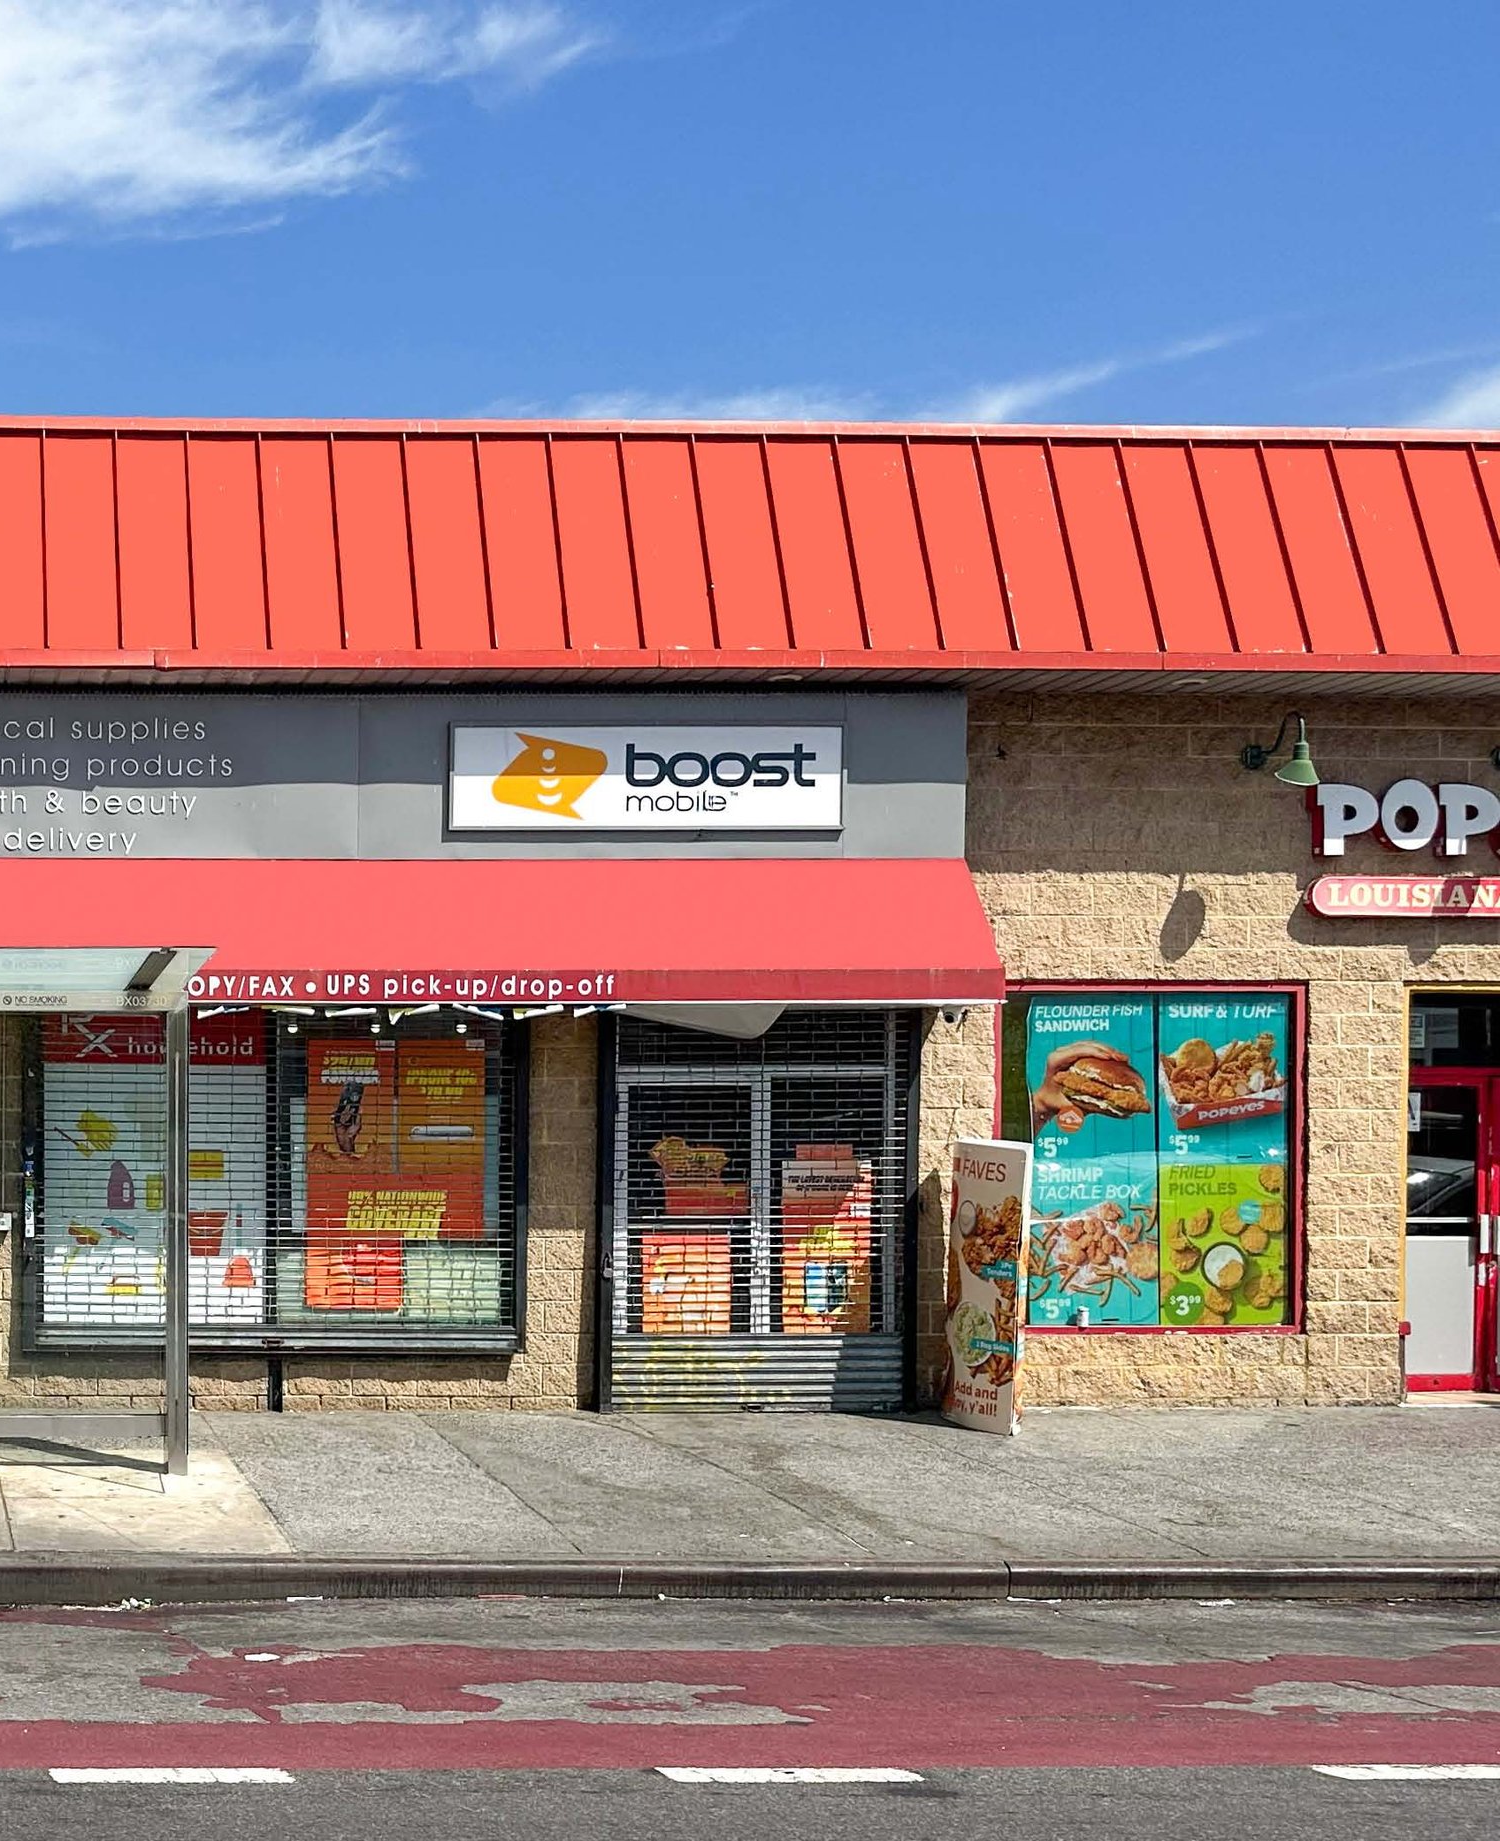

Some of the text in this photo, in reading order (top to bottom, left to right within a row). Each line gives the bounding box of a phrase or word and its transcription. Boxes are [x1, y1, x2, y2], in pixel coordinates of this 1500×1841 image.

[71, 717, 206, 745] supplies
[87, 754, 233, 781] products
[625, 743, 816, 788] boost
[44, 791, 66, 815] &
[82, 790, 197, 819] beauty
[626, 791, 727, 812] mobile
[3, 827, 137, 856] delivery
[1326, 883, 1500, 909] LOUISIAN
[187, 975, 616, 999] OPY/FAX UPS pick-up/drop-off
[15, 996, 67, 1004] NO SMOKING
[1035, 1004, 1143, 1019] FLOUNDER FISH
[1169, 1004, 1276, 1018] SURF & TURF
[1035, 1018, 1109, 1033] SANDWICH
[128, 1036, 253, 1056] houehold
[962, 1159, 1007, 1182] FAVES
[1037, 1166, 1103, 1183] SHRIMP
[1169, 1165, 1216, 1180] FRIED
[1037, 1185, 1141, 1200] TACKLE BOX
[1169, 1182, 1237, 1196] PICKLES
[955, 1381, 998, 1401] Add and
